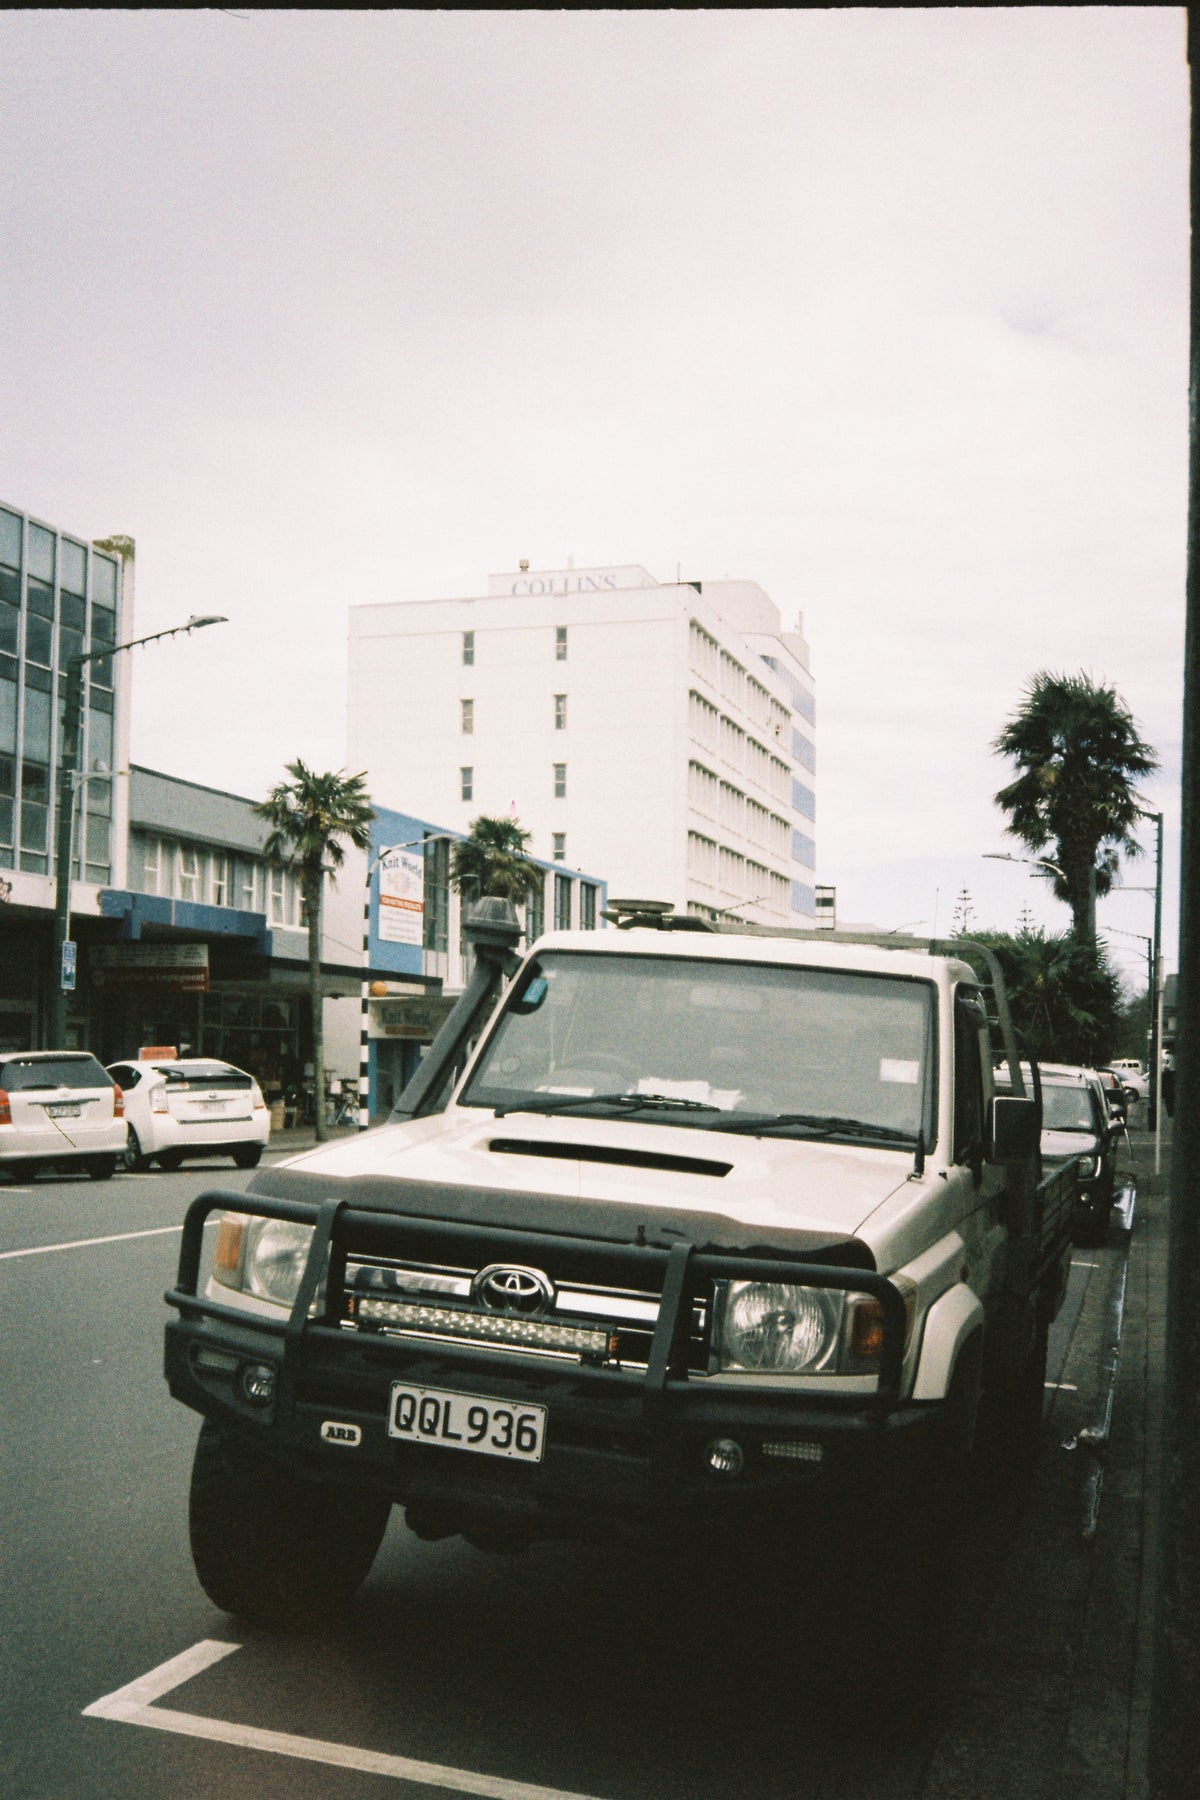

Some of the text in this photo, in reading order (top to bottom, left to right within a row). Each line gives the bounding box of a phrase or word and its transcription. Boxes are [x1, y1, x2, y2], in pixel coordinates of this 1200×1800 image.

[511, 574, 617, 596] COLLINS
[381, 855, 422, 880] Knit World
[156, 974, 205, 983] Employment
[326, 1426, 357, 1442] ARB
[394, 1393, 538, 1453] QQL936
